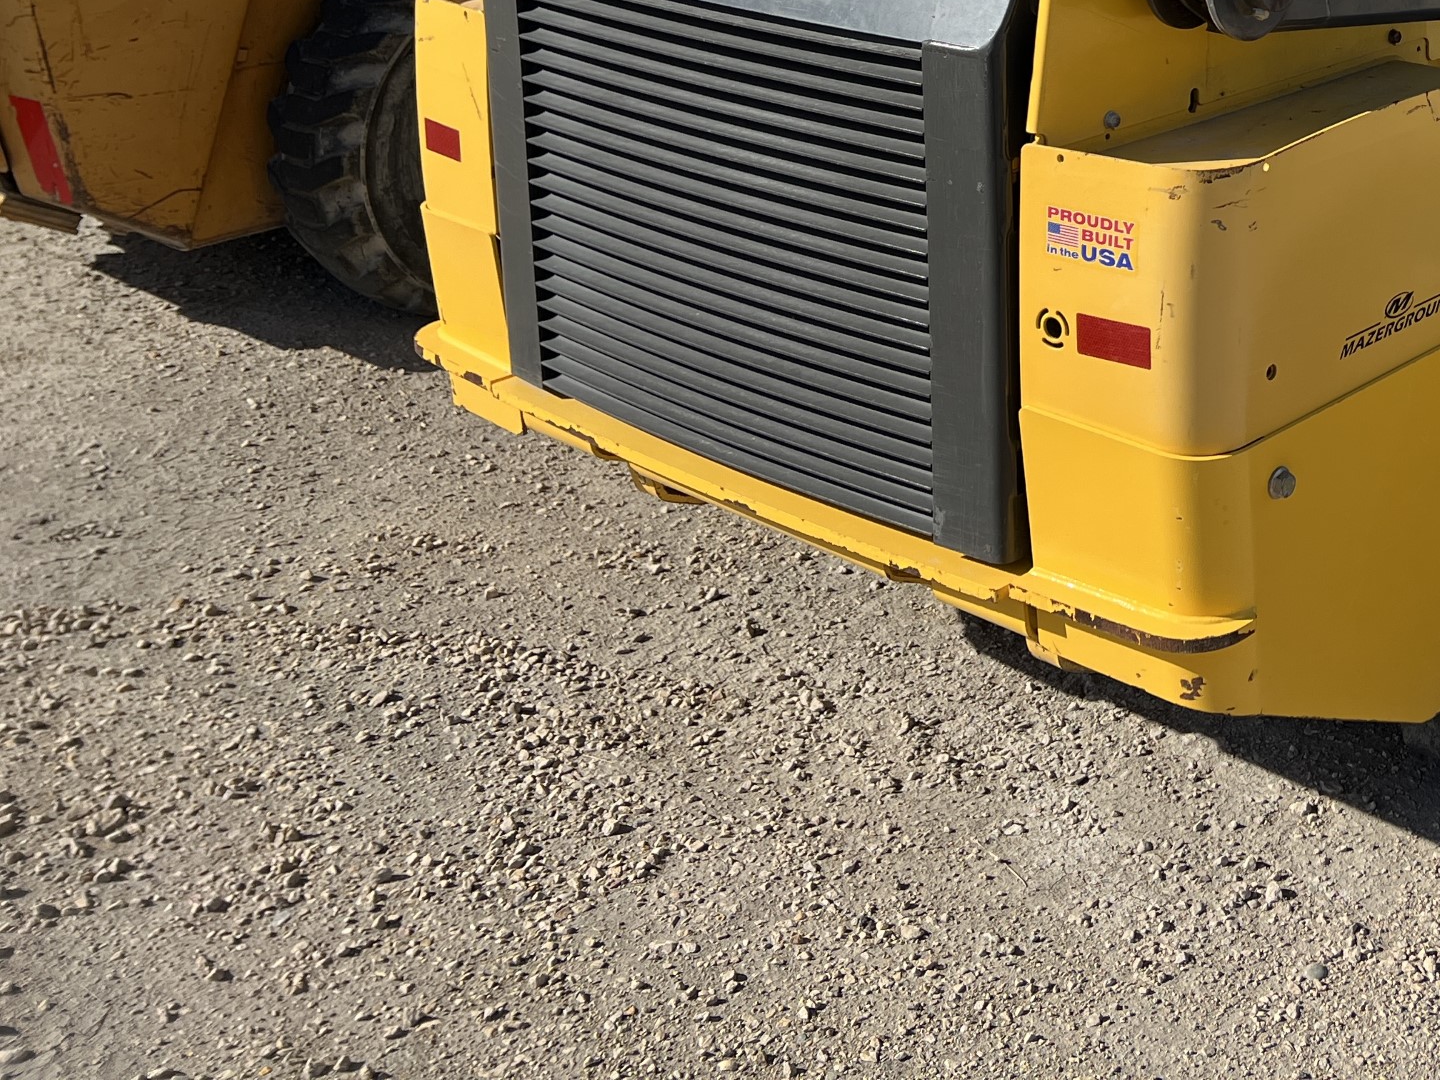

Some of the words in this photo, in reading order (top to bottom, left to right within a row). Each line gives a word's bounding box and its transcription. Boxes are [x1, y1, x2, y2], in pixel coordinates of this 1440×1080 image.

[1047, 206, 1135, 235] PROUDLY
[1081, 228, 1135, 251] BUILT
[1046, 243, 1058, 255] in
[1059, 247, 1080, 259] the
[1081, 244, 1134, 271] USA
